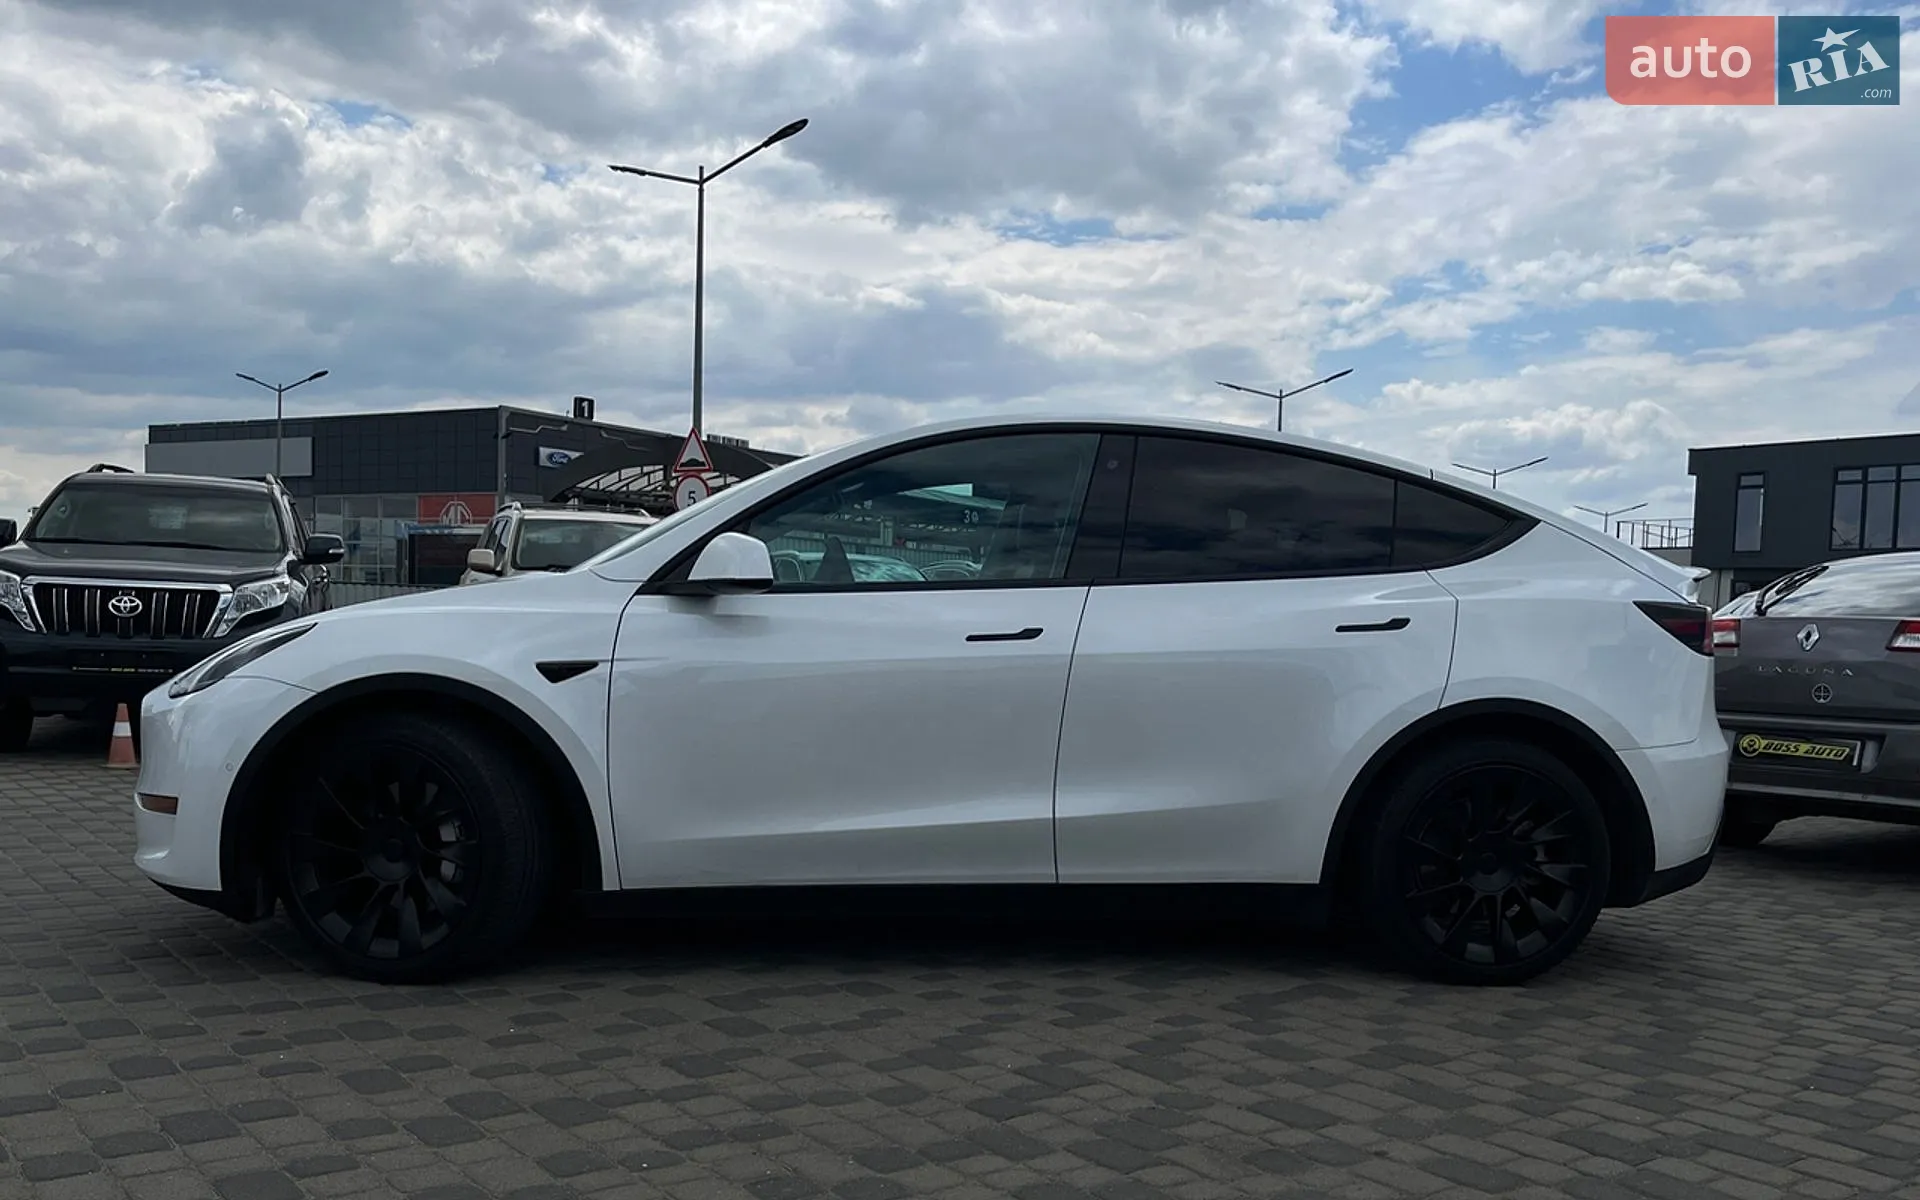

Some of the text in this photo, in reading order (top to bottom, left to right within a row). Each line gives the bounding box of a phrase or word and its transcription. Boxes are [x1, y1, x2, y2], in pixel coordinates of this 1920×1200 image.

[581, 400, 589, 418] 1
[687, 490, 697, 507] 5
[1758, 665, 1854, 676] LAGUNA
[1762, 740, 1847, 758] BOSS AUTO
